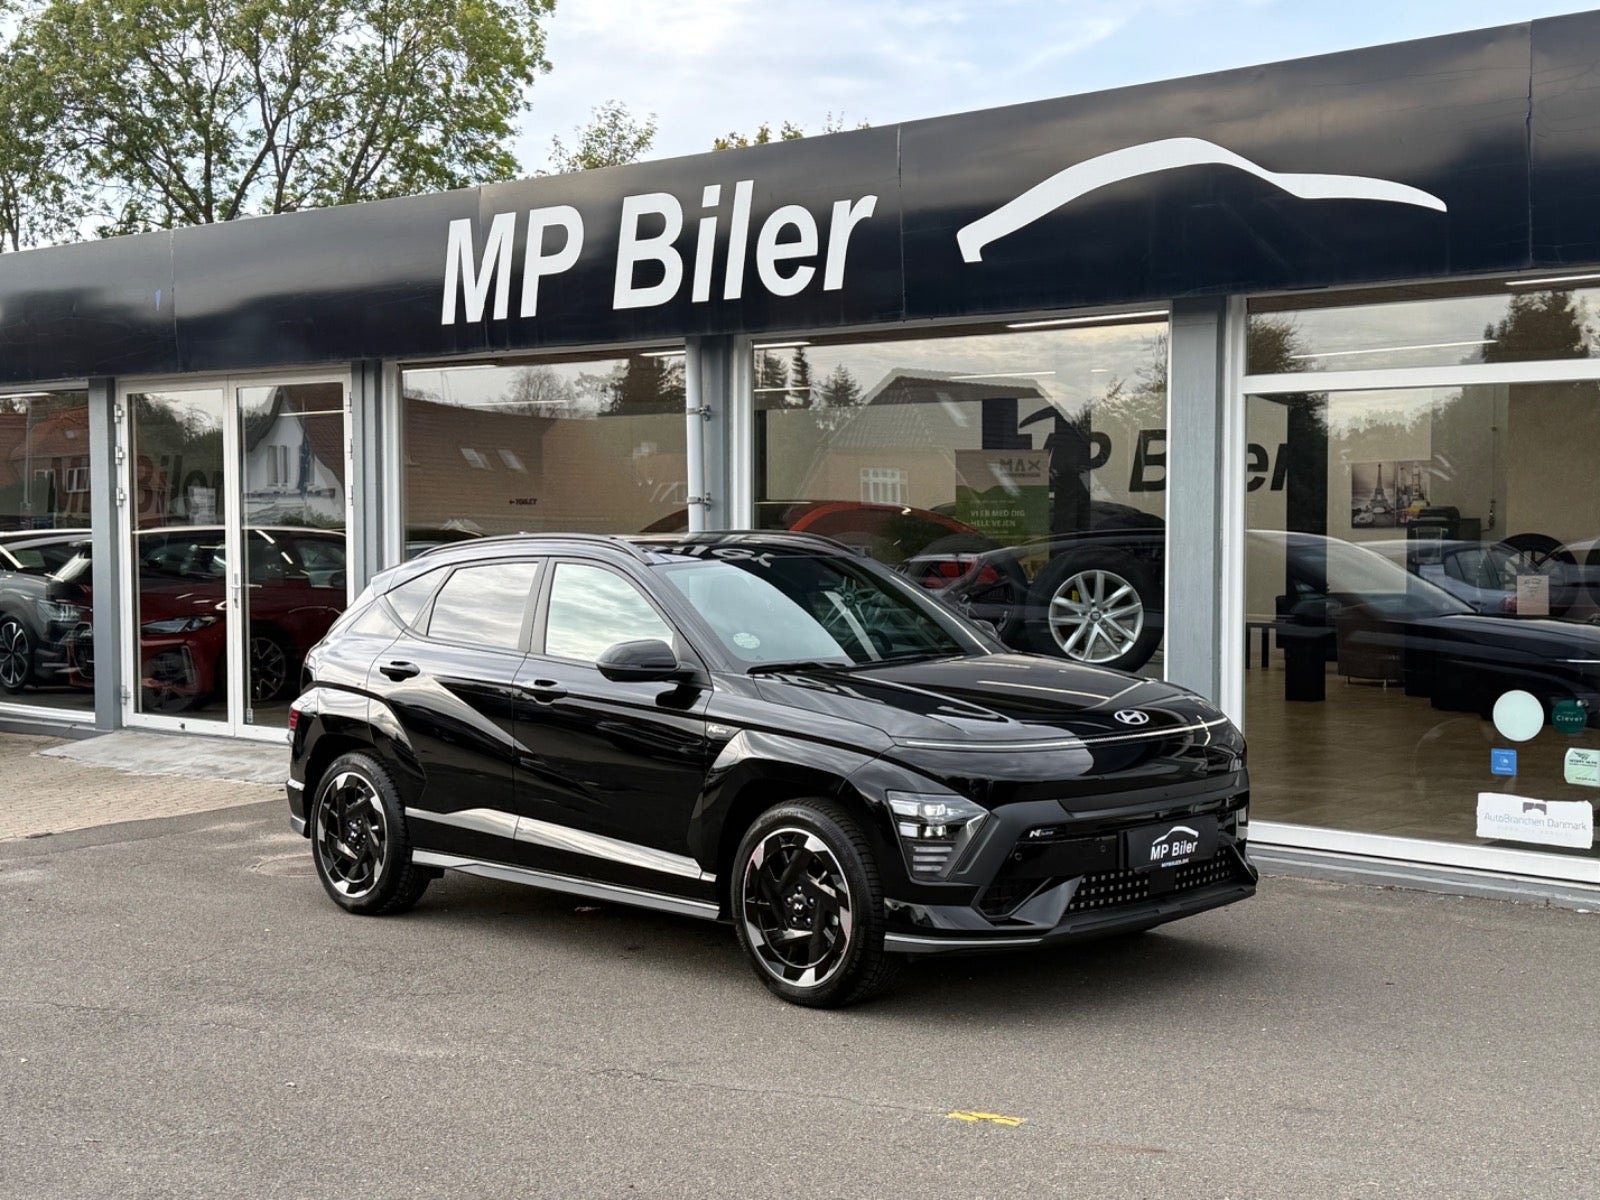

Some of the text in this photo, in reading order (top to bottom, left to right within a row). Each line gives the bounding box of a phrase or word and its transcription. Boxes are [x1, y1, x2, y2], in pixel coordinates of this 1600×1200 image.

[441, 179, 878, 326] MP Biler
[999, 458, 1041, 472] MAX
[1484, 812, 1545, 827] AutoBranchen
[1547, 818, 1588, 831] Danmark
[1150, 840, 1198, 861] MP Biler
